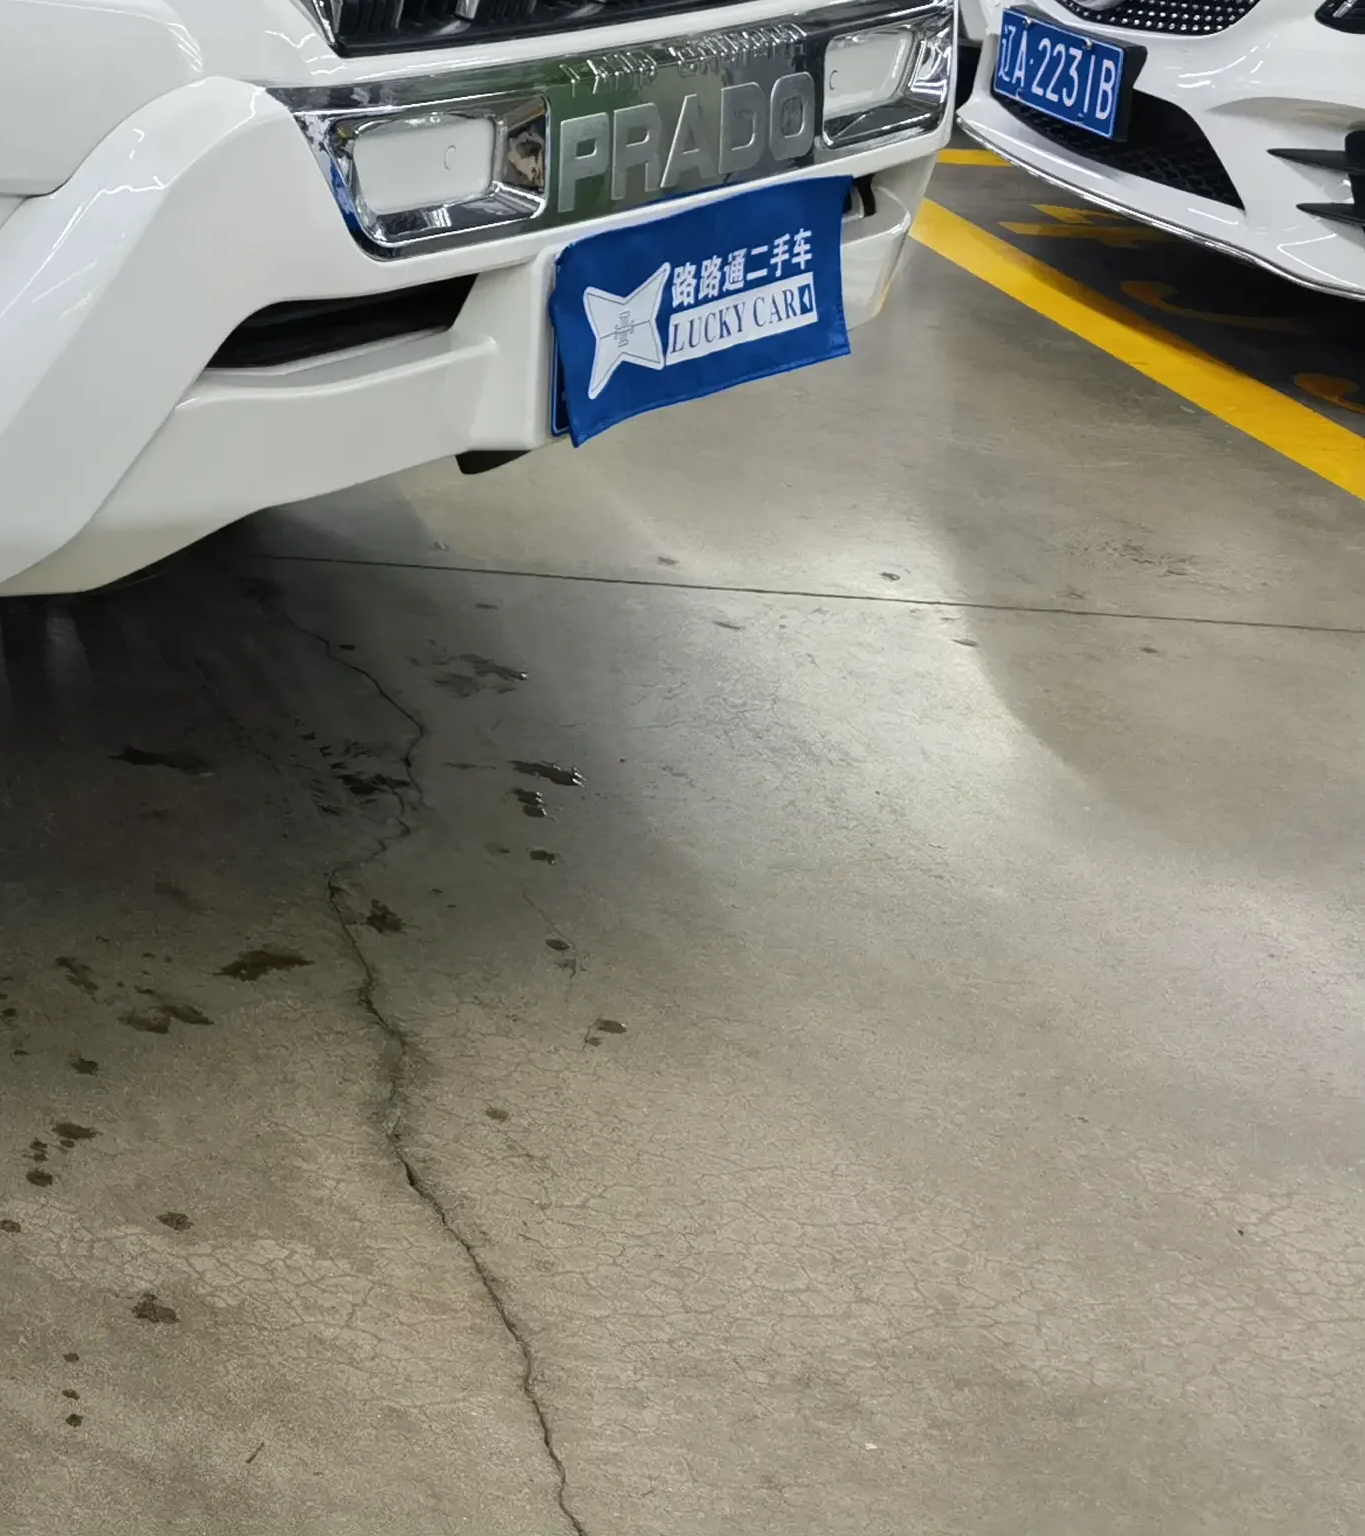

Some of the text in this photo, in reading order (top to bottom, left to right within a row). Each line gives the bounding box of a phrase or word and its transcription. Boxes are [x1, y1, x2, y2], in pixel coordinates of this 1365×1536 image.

[557, 71, 816, 214] PRADO
[671, 228, 813, 308] 路路通二手车
[671, 288, 797, 354] LUCKY CAR
